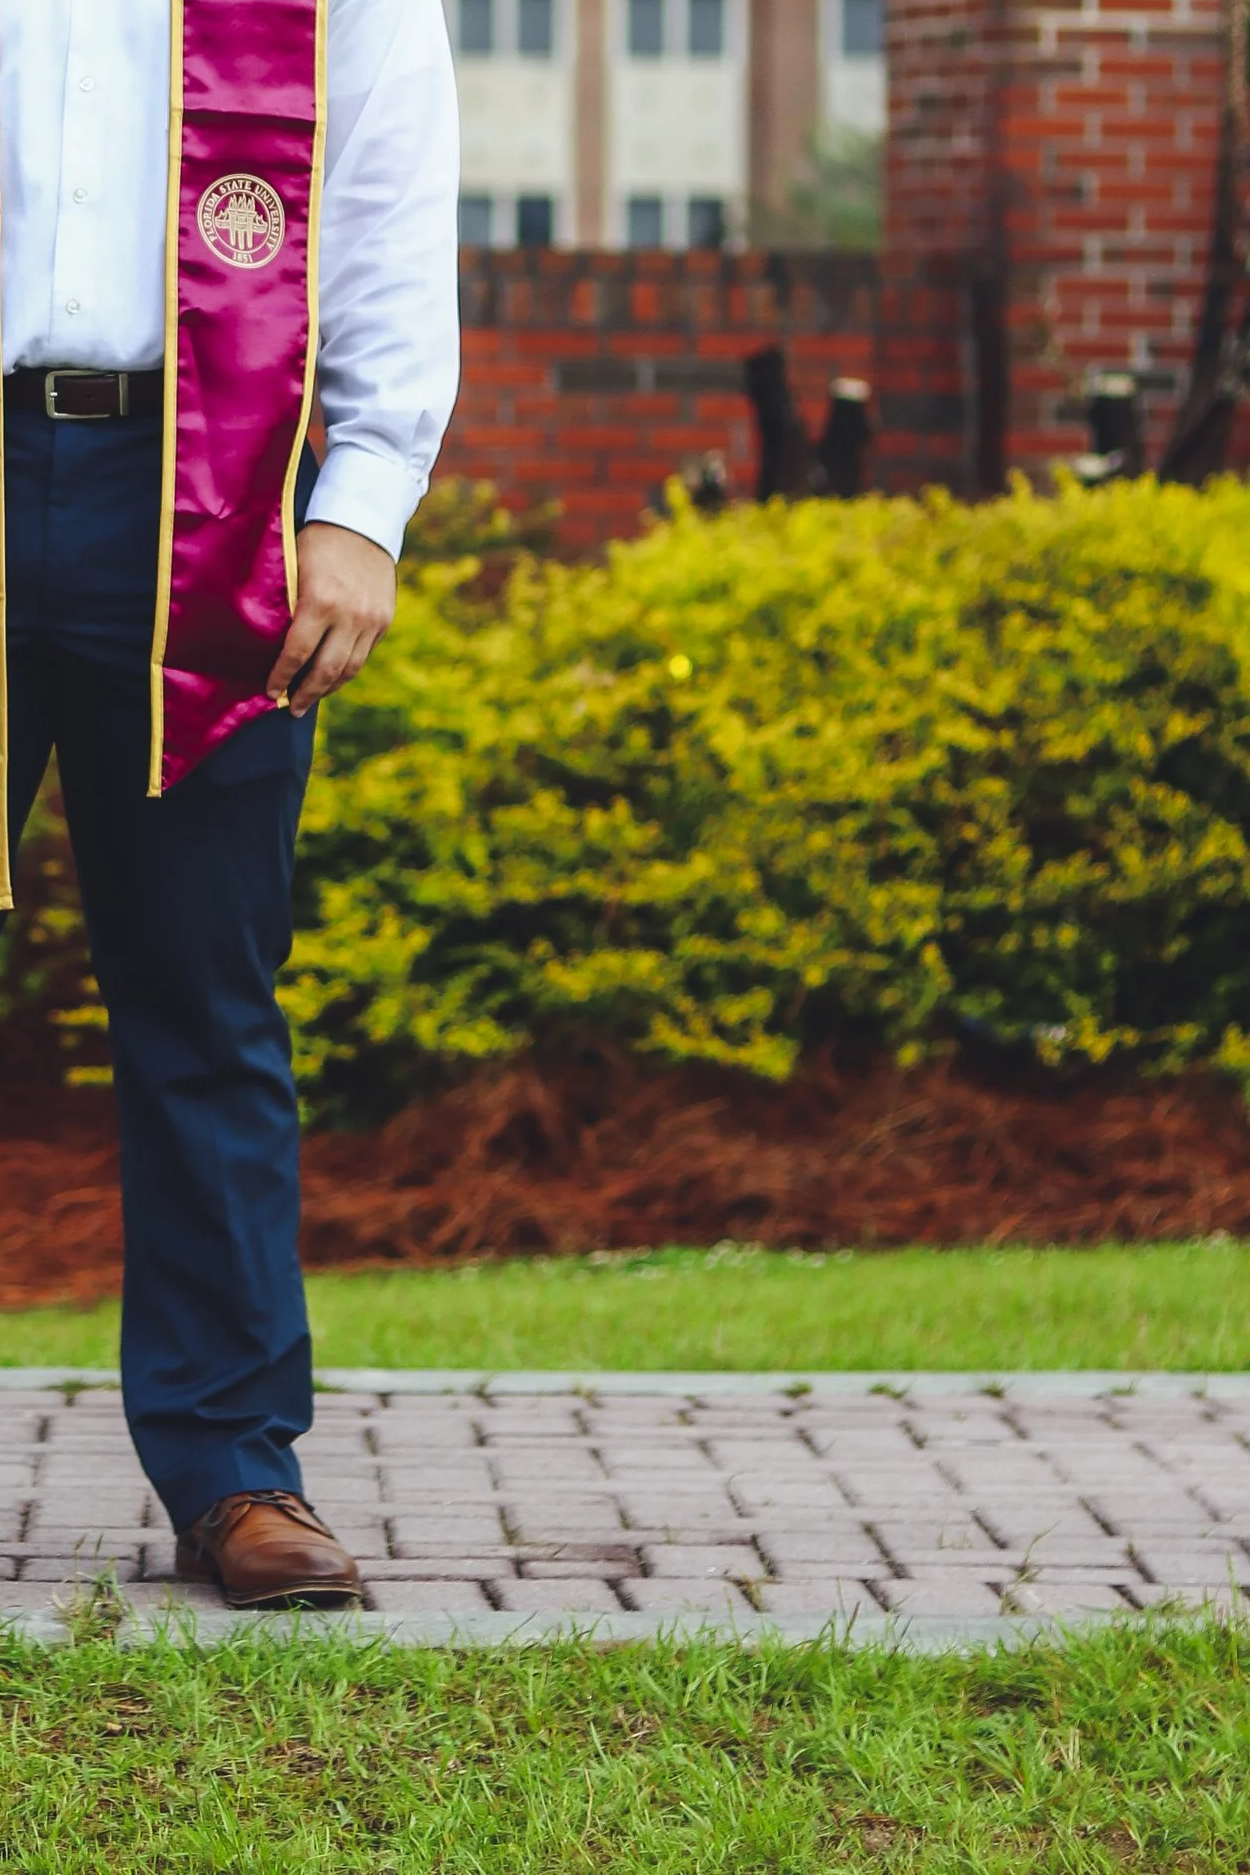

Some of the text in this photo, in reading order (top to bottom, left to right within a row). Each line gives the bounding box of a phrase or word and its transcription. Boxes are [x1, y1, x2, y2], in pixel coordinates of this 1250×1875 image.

[203, 179, 280, 252] FLORIDA STATE UNIVERSITY
